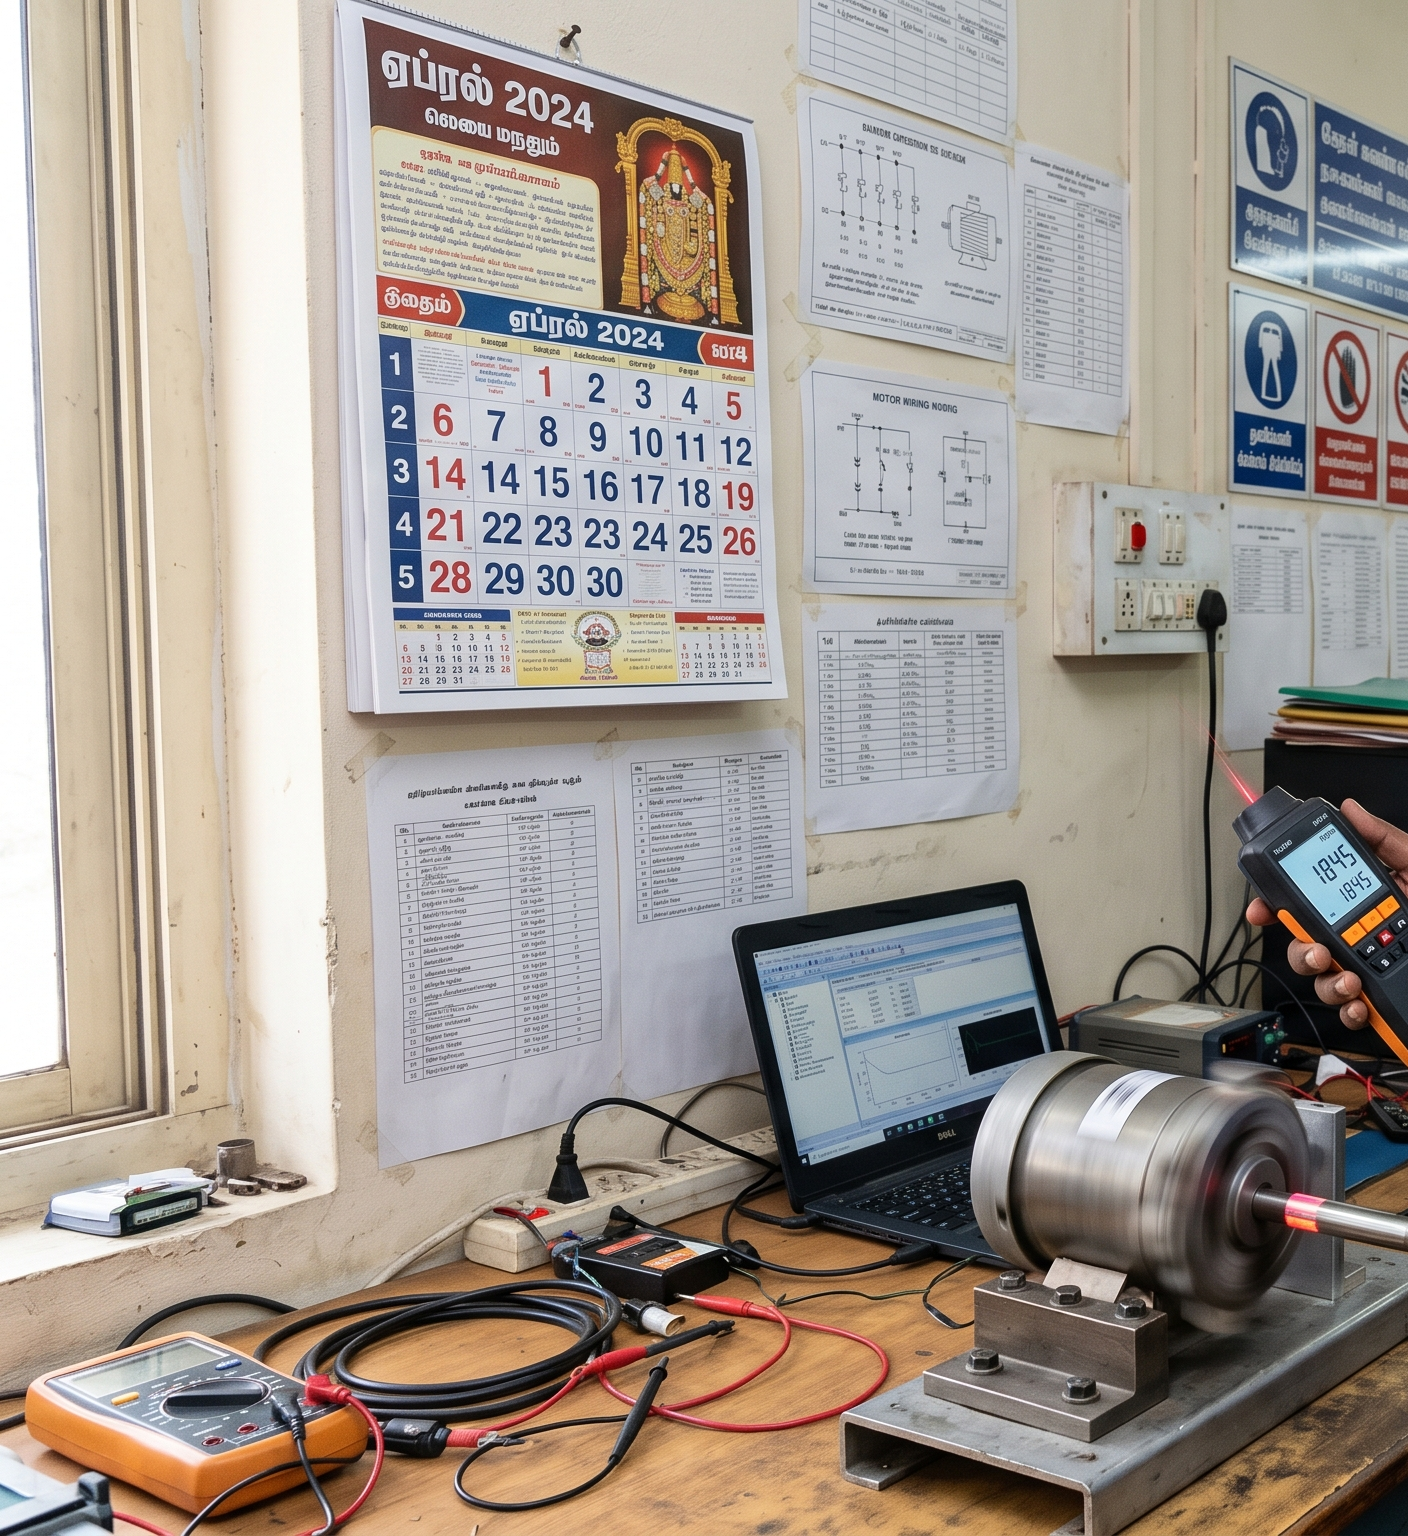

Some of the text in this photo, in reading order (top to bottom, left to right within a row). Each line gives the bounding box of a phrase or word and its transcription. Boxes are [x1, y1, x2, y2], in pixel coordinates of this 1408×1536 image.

[382, 48, 594, 134] ஏப்ரல் 2024
[509, 307, 664, 351] ஏப்ரல் 2024
[390, 352, 400, 375] 1
[539, 366, 550, 397] 1
[589, 373, 605, 403] 2
[636, 379, 651, 409] 3
[682, 387, 698, 414] 4
[727, 392, 741, 420] 5
[873, 393, 900, 404] MOTOR
[903, 398, 929, 409] WIRING
[391, 404, 752, 466] 2 6 7 8 9 10 11 12
[394, 456, 753, 511] 3 14 14 15 16 17 18 19
[396, 508, 755, 555] 4 21 22 23 23 24 25 26
[399, 565, 414, 588] 5
[430, 560, 471, 593] 28
[485, 562, 524, 594] 29
[537, 565, 574, 596] 30
[587, 567, 622, 597] 30
[1312, 844, 1357, 884] 1845
[1339, 871, 1372, 902] 1845
